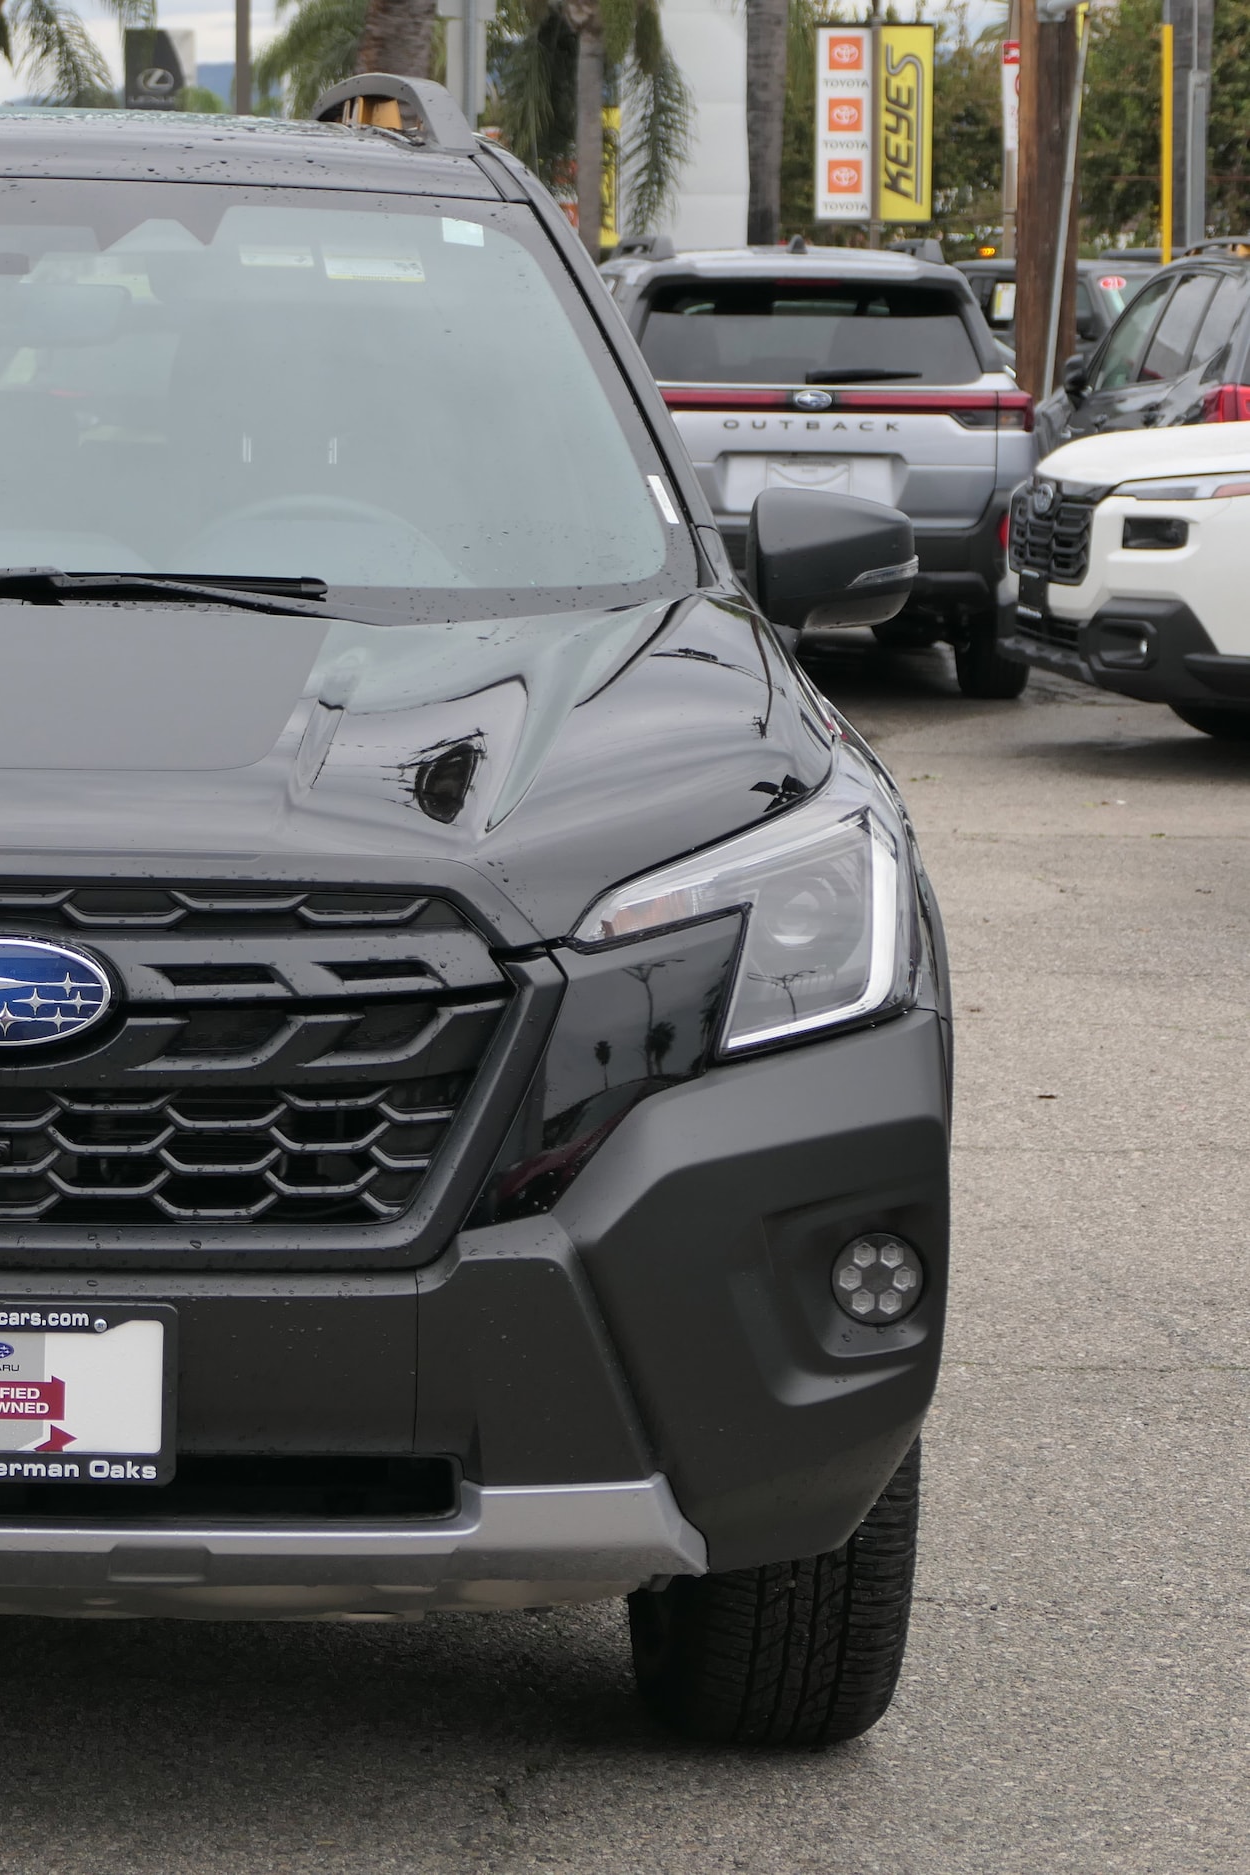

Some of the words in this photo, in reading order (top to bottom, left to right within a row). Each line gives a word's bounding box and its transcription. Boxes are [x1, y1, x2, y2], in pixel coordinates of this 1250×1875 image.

[823, 78, 870, 89] TOYOTA
[884, 43, 924, 206] KEYES
[823, 140, 870, 151] TOYOTA
[822, 201, 869, 212] TOYOTA
[722, 419, 901, 433] OUTBACK
[89, 1460, 158, 1480] Oaks
